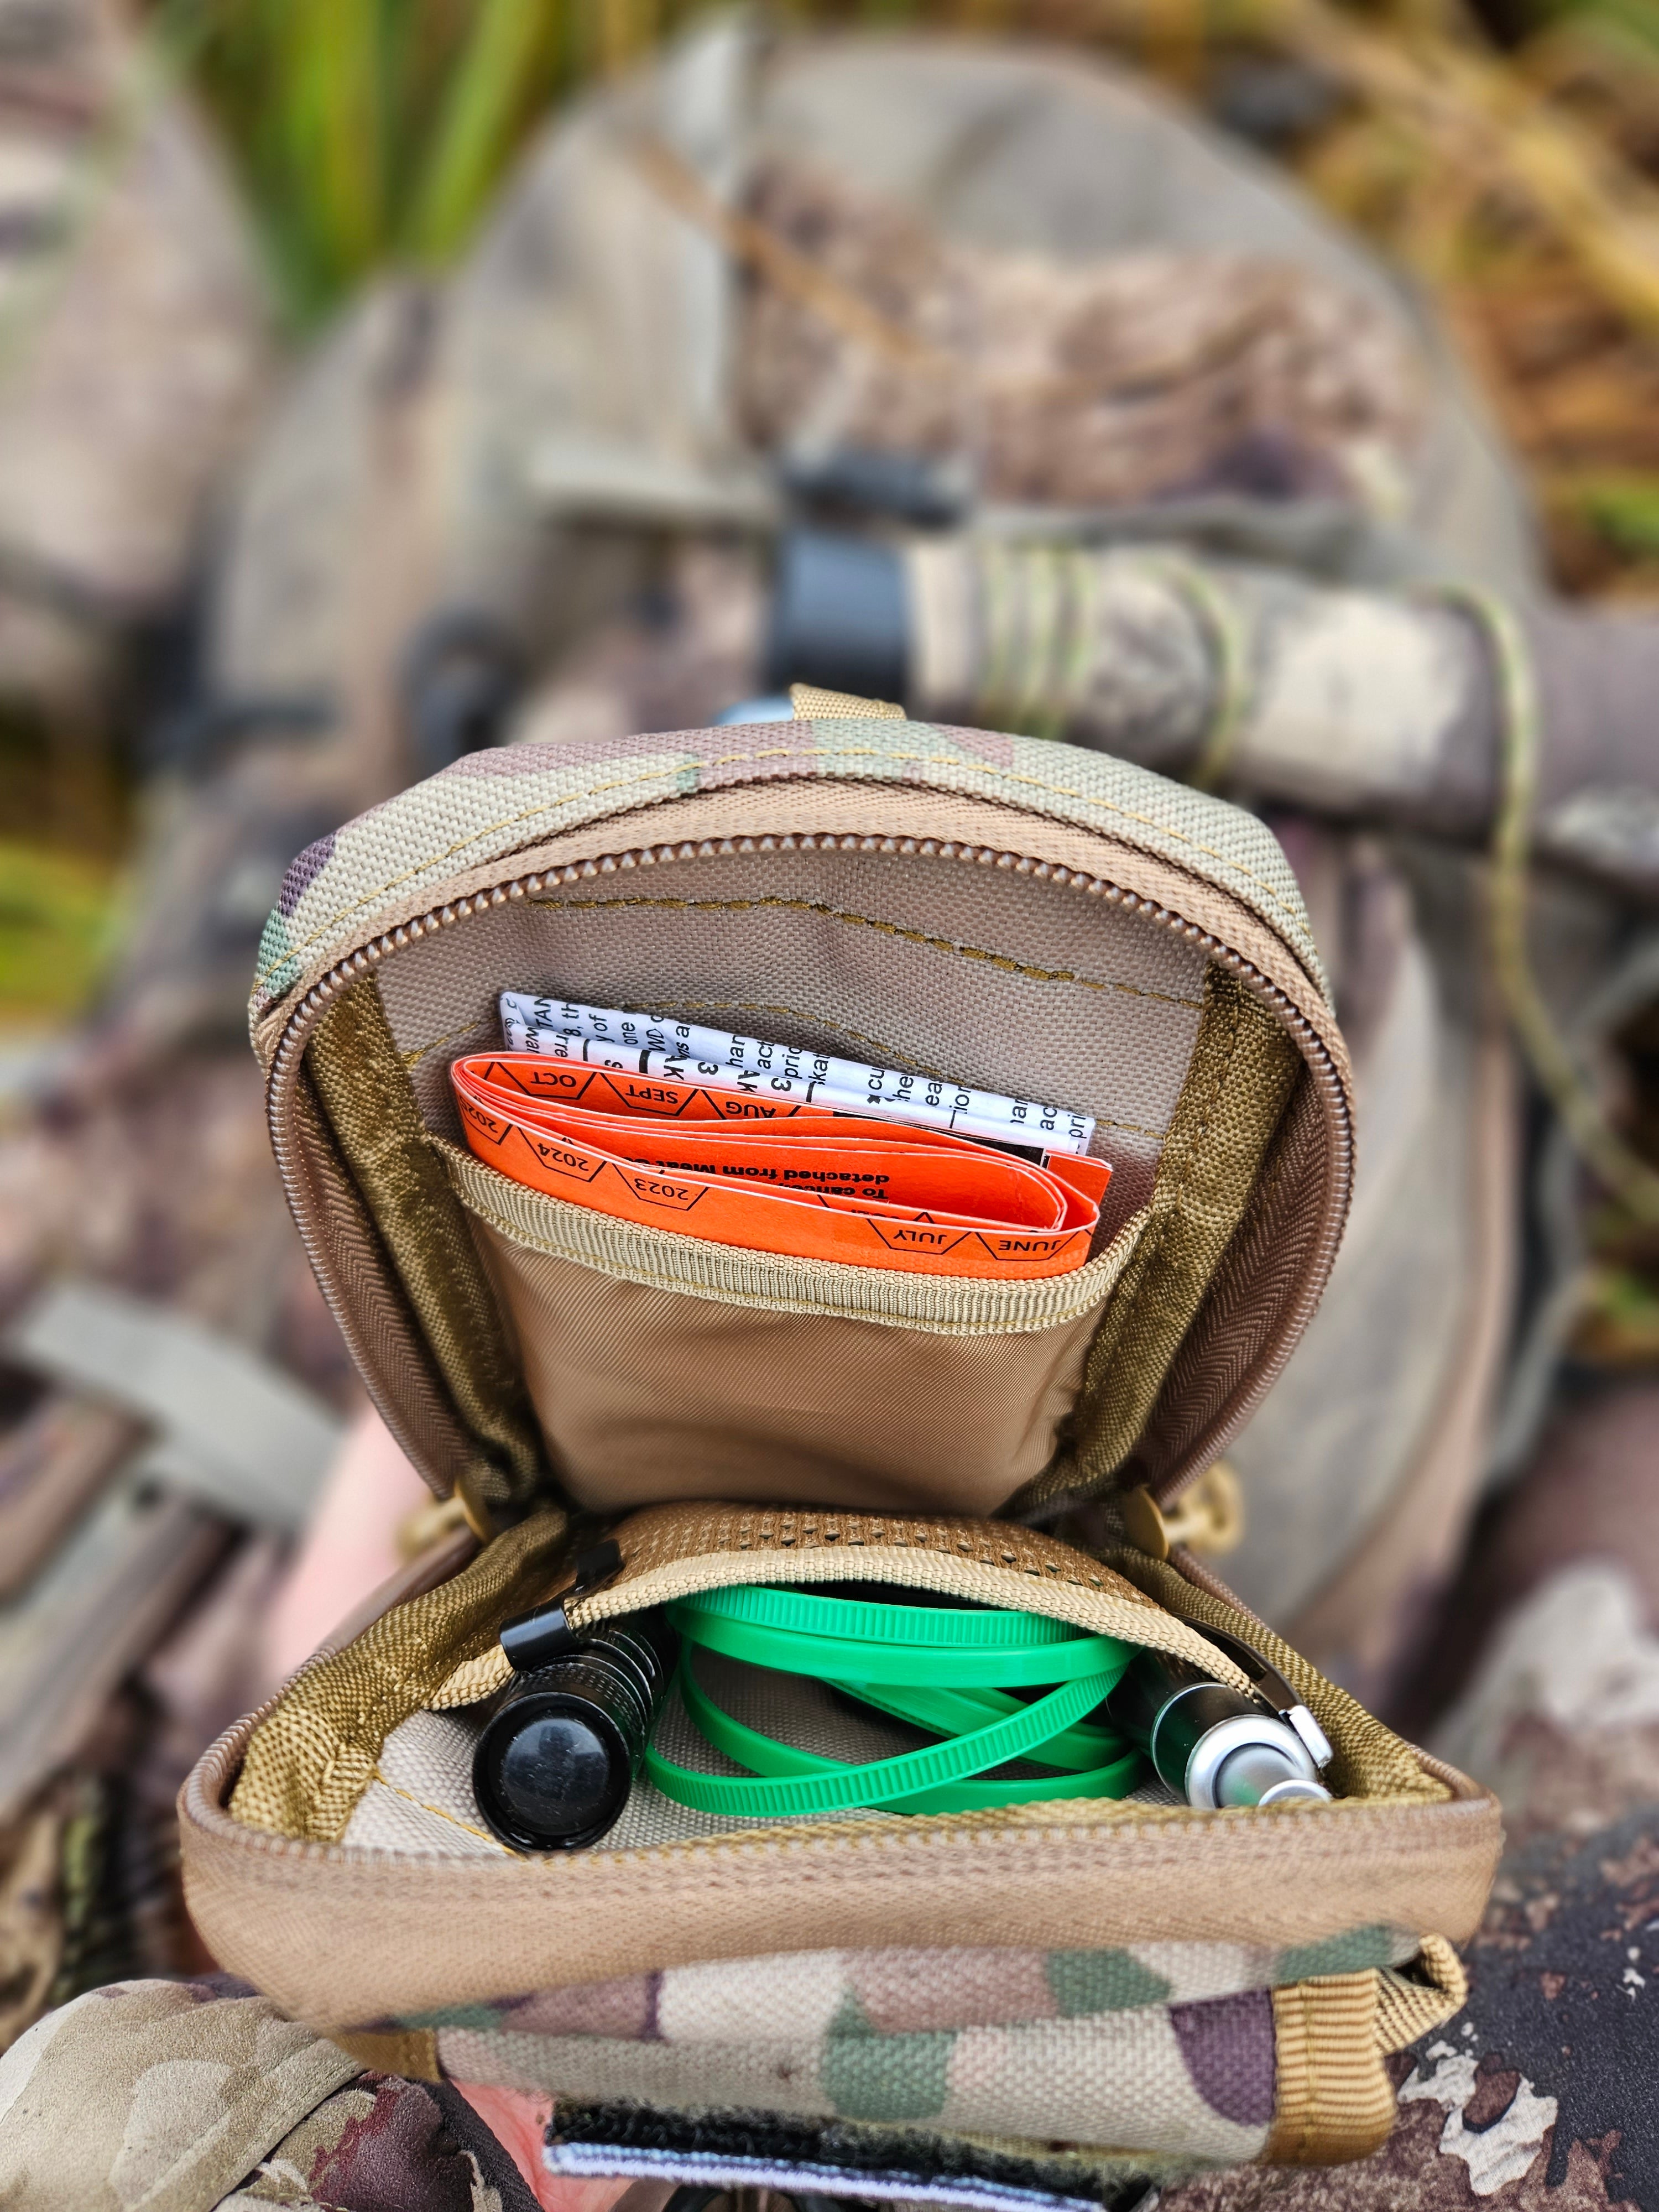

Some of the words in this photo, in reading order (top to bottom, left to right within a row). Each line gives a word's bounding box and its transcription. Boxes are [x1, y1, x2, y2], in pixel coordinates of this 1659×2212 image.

[589, 1013, 608, 1032] of
[622, 1022, 639, 1045] one
[676, 1024, 691, 1039] a
[697, 1062, 718, 1076] 3
[530, 1071, 577, 1088] OCT
[771, 1077, 792, 1092] 3
[625, 1084, 679, 1104] SEPT
[725, 1101, 777, 1118] AUG
[538, 1142, 590, 1171] 2024
[723, 1165, 777, 1180] from
[784, 1170, 890, 1185] detached
[634, 1177, 689, 1201] 2023
[863, 1187, 889, 1199] To
[893, 1228, 947, 1245] JULY
[999, 1239, 1062, 1253] JUNE
